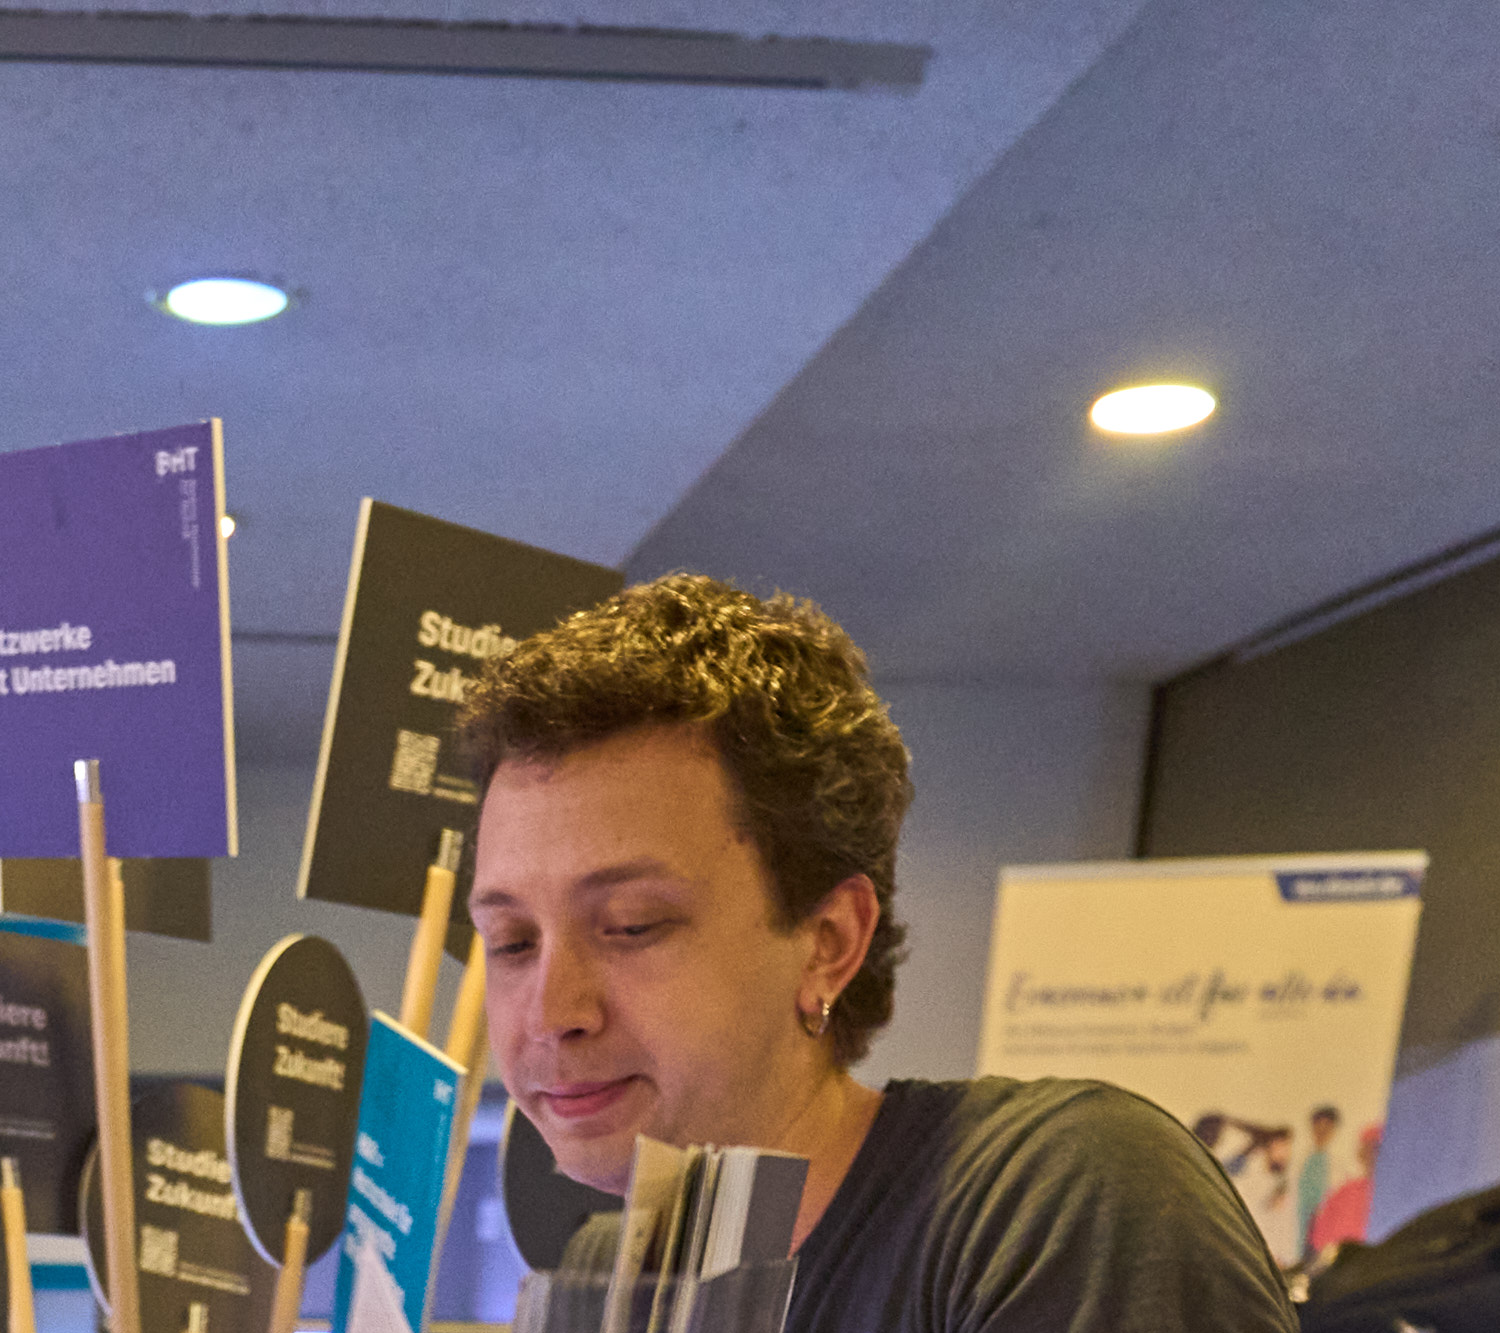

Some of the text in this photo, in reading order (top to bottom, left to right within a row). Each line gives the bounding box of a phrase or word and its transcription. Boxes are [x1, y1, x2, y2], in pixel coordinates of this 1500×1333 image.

[418, 610, 517, 659] Studie
[10, 658, 176, 695] Unternehmen
[410, 659, 463, 703] Zuk
[146, 1138, 232, 1183] Studie
